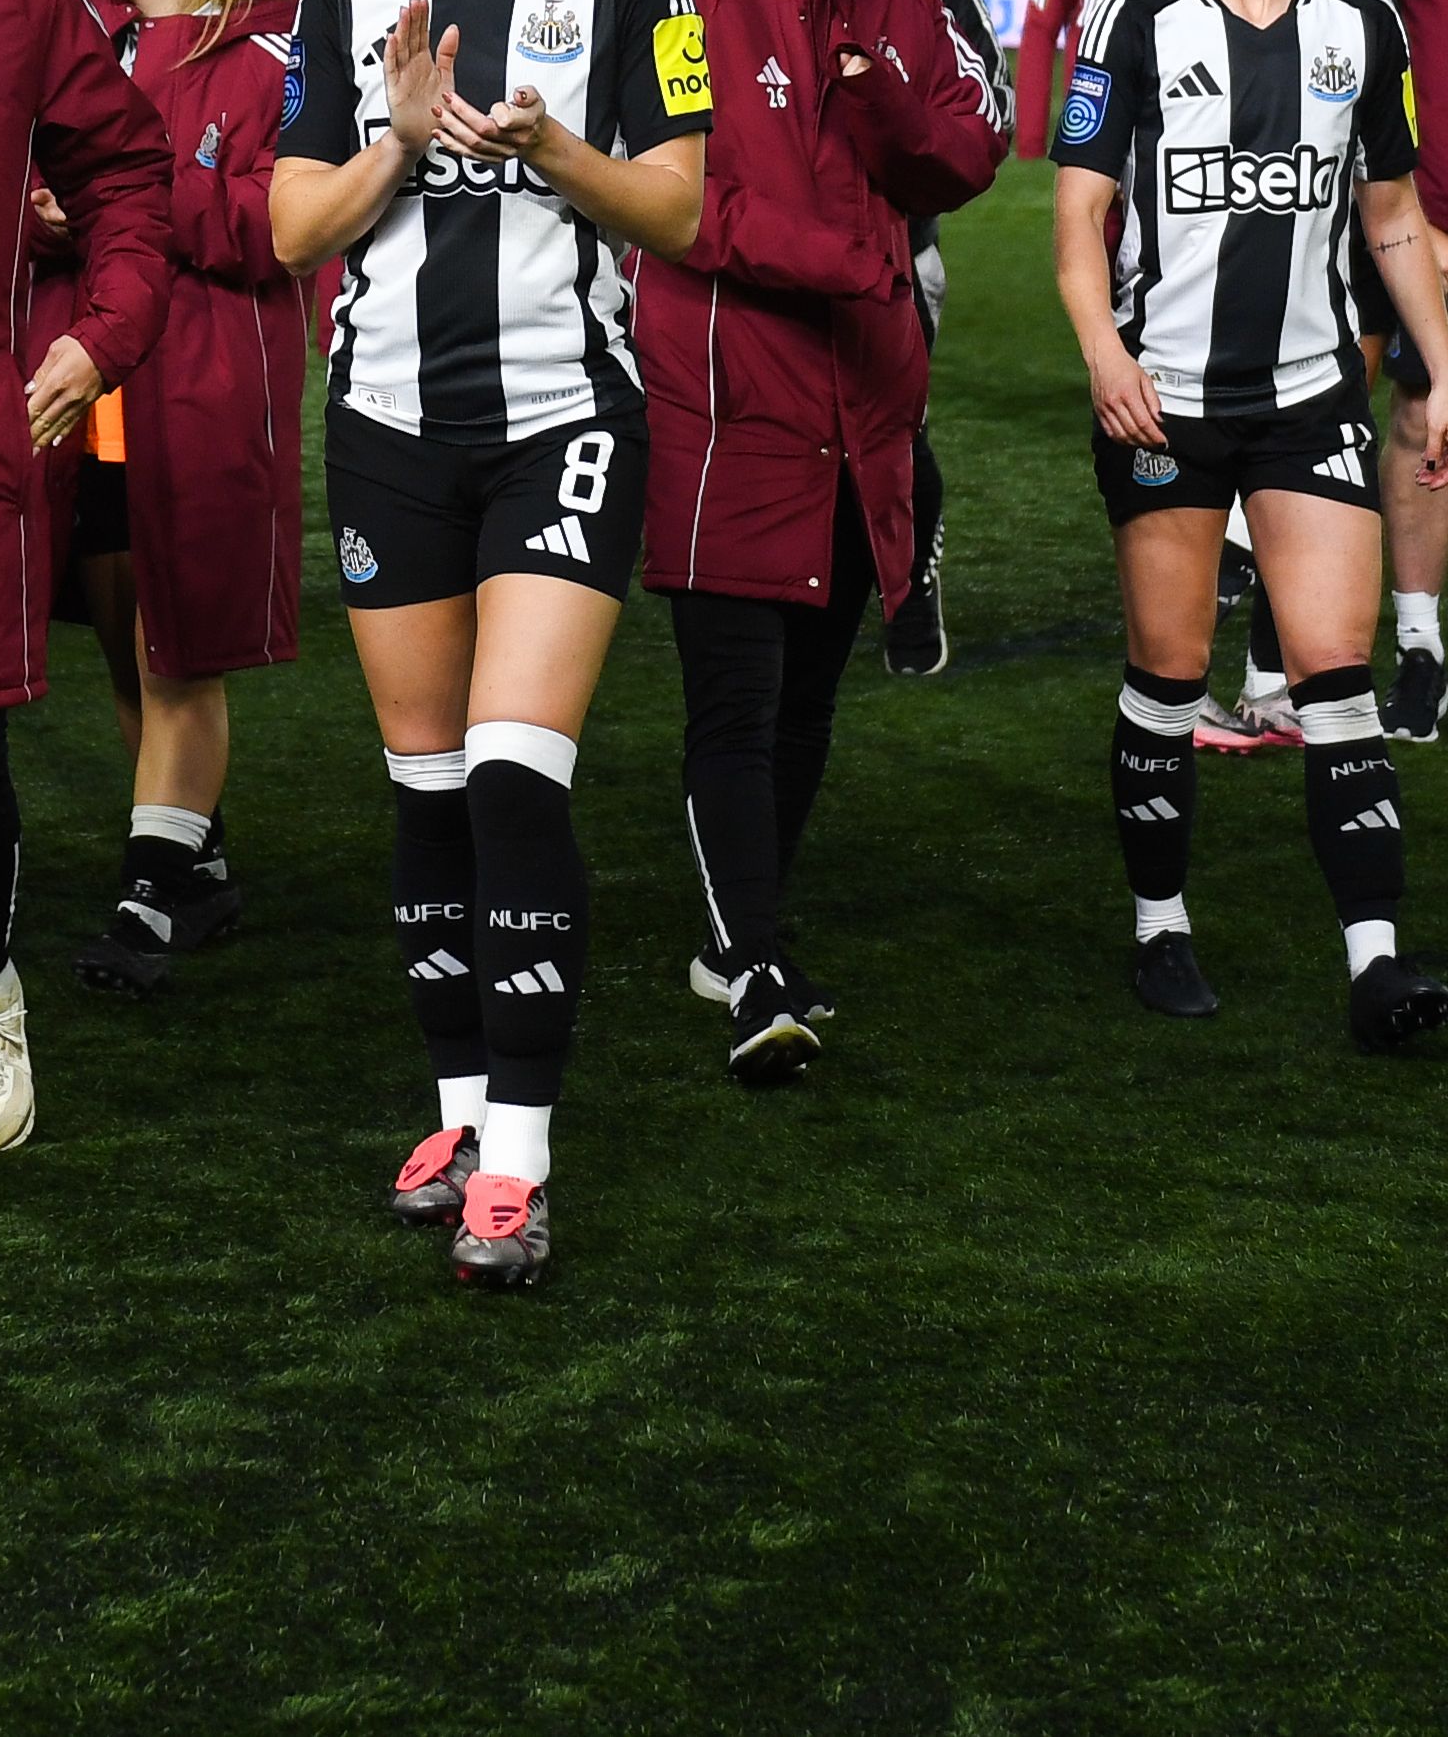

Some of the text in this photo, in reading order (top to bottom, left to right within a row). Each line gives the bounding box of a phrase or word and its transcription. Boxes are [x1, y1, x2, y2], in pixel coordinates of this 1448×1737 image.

[766, 87, 788, 108] 26
[557, 431, 615, 514] 8
[1120, 749, 1182, 773] NUFC
[395, 903, 465, 923] NUFC
[489, 909, 571, 931] NUFC
